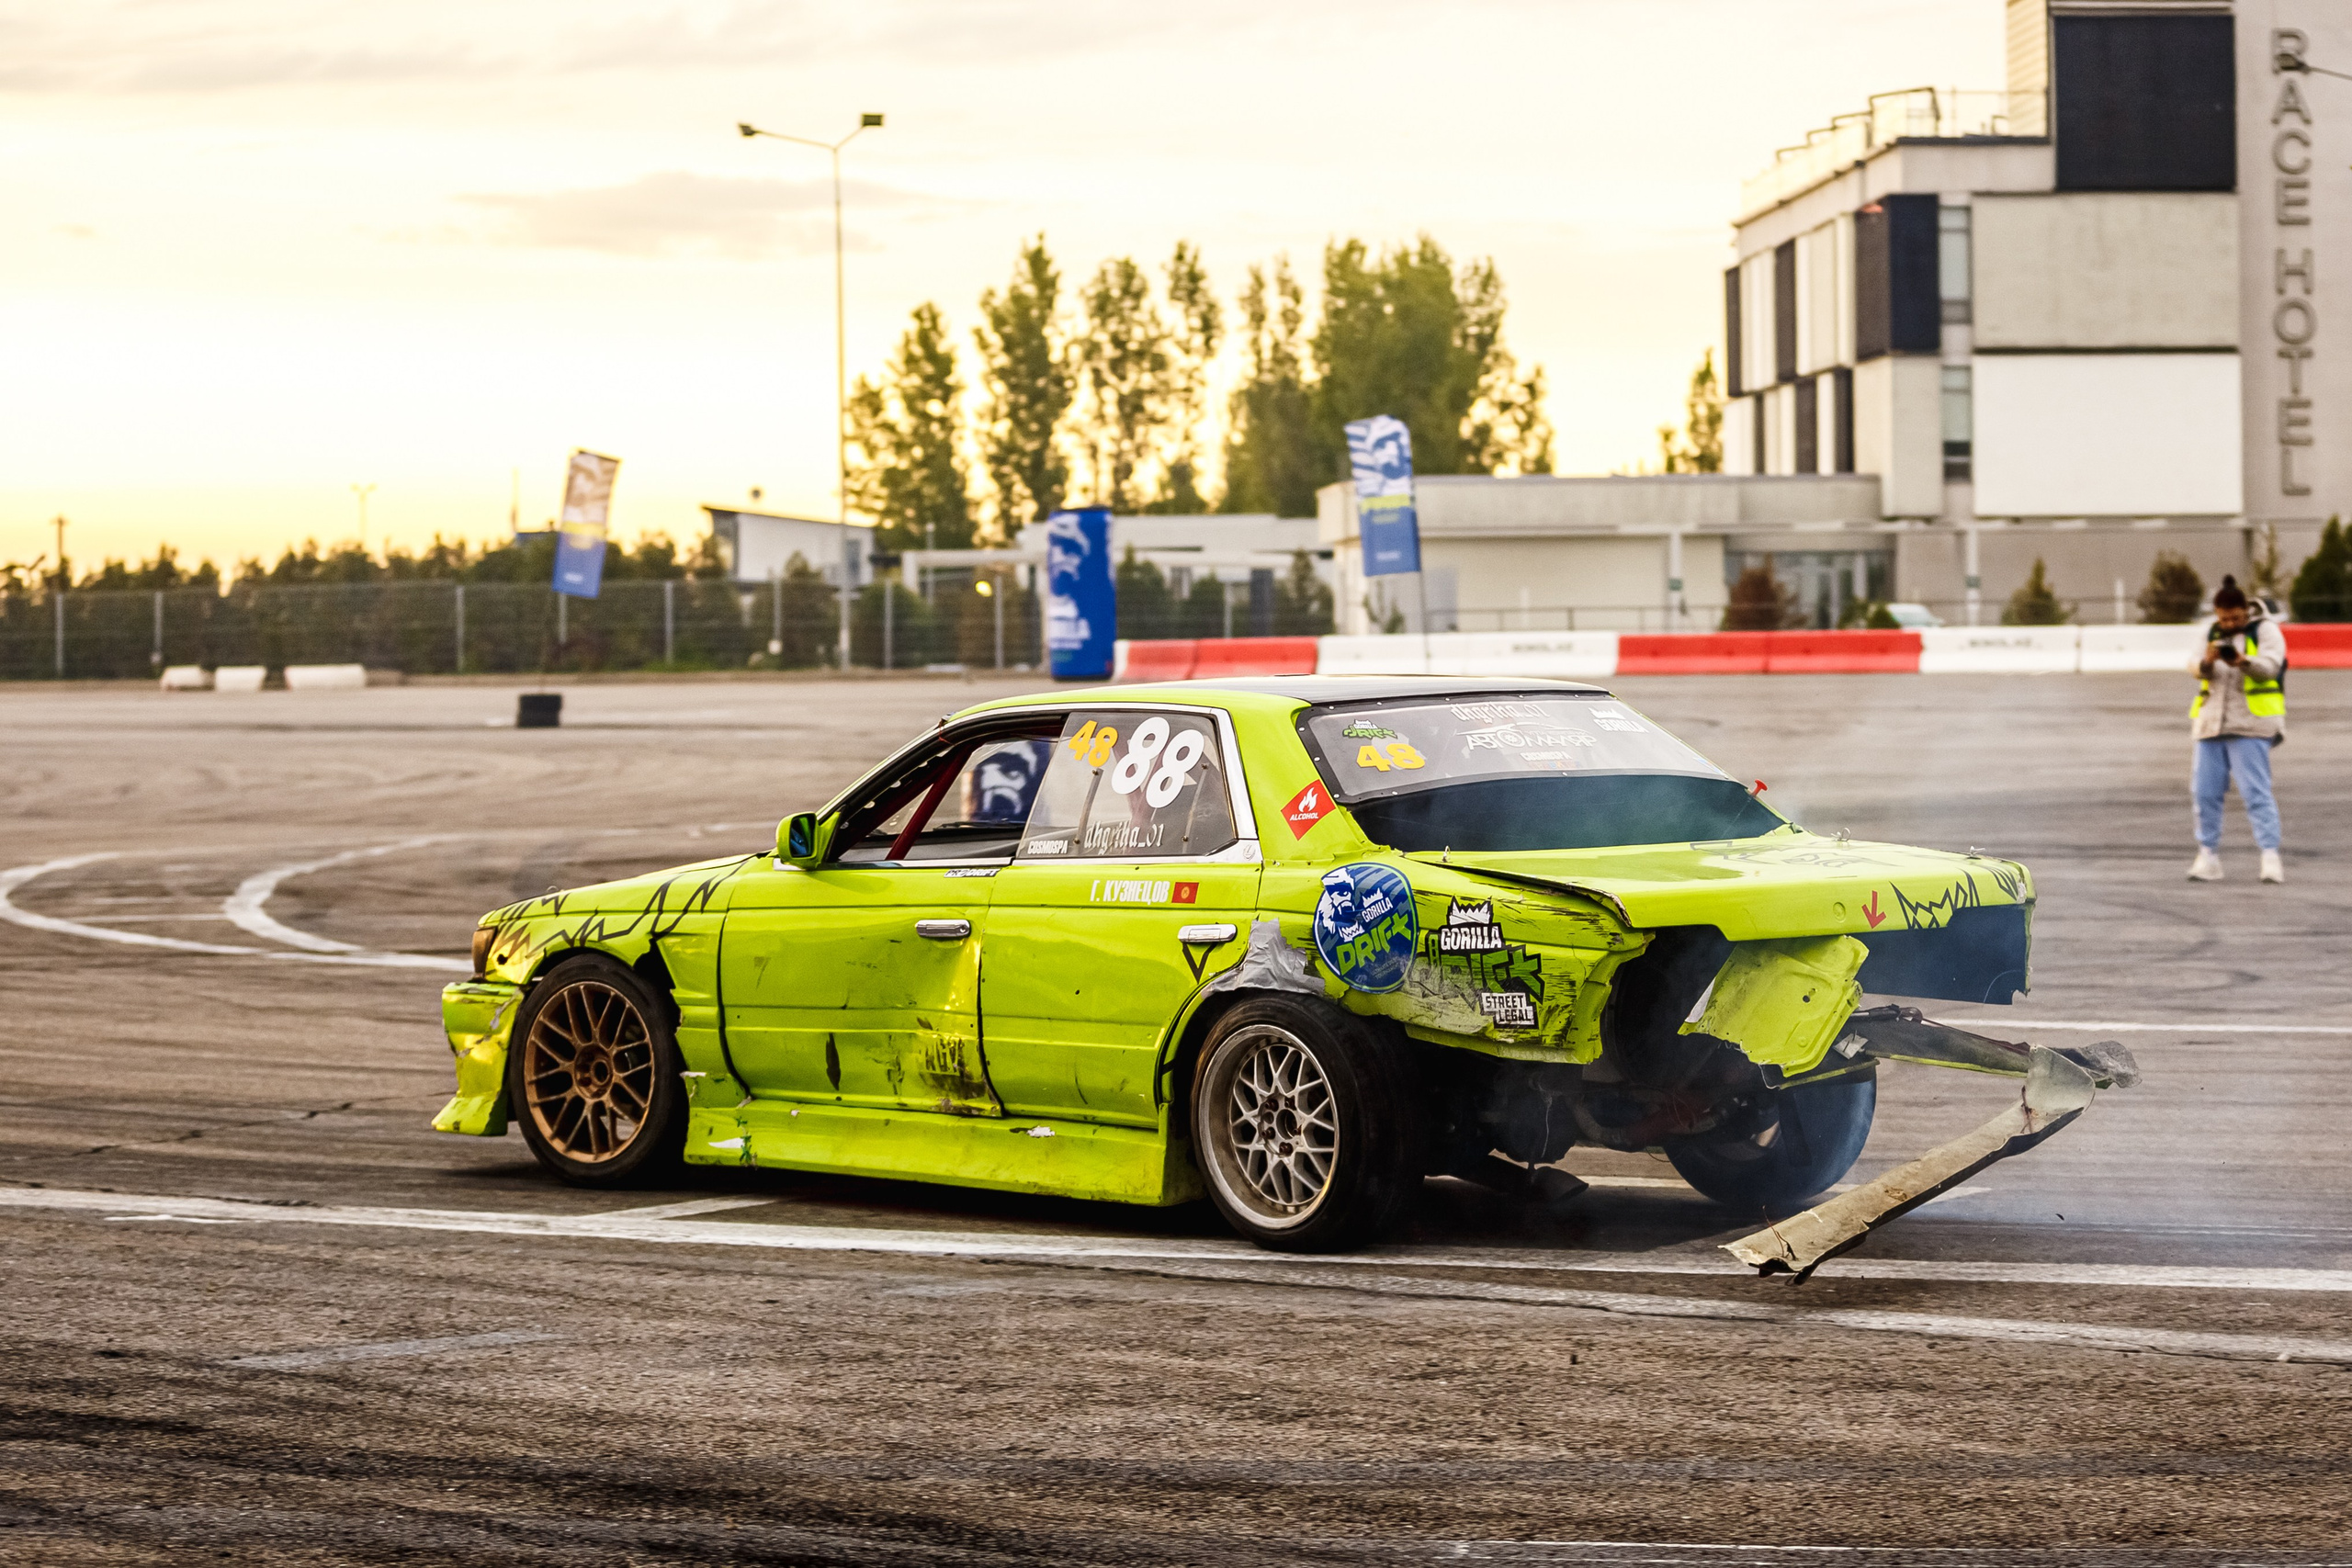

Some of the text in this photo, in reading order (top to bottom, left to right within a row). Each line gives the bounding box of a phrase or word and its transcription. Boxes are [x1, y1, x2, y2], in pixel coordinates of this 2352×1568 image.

[2270, 27, 2317, 497] RACE HOTEL
[1593, 718, 1650, 733] GORILLA
[1069, 720, 1118, 768] 48
[1112, 716, 1204, 808] 88
[1356, 742, 1426, 772] 48
[1289, 812, 1319, 821] ALCOHOL
[1027, 840, 1069, 854] COSMOSPA
[1090, 879, 1170, 906] Г. КУЗНЕЦОВ
[1362, 897, 1394, 922] GORILLA
[1441, 926, 1502, 950] GORILLA
[1485, 995, 1524, 1009] STREET
[1498, 1010, 1532, 1022] LEGAL
